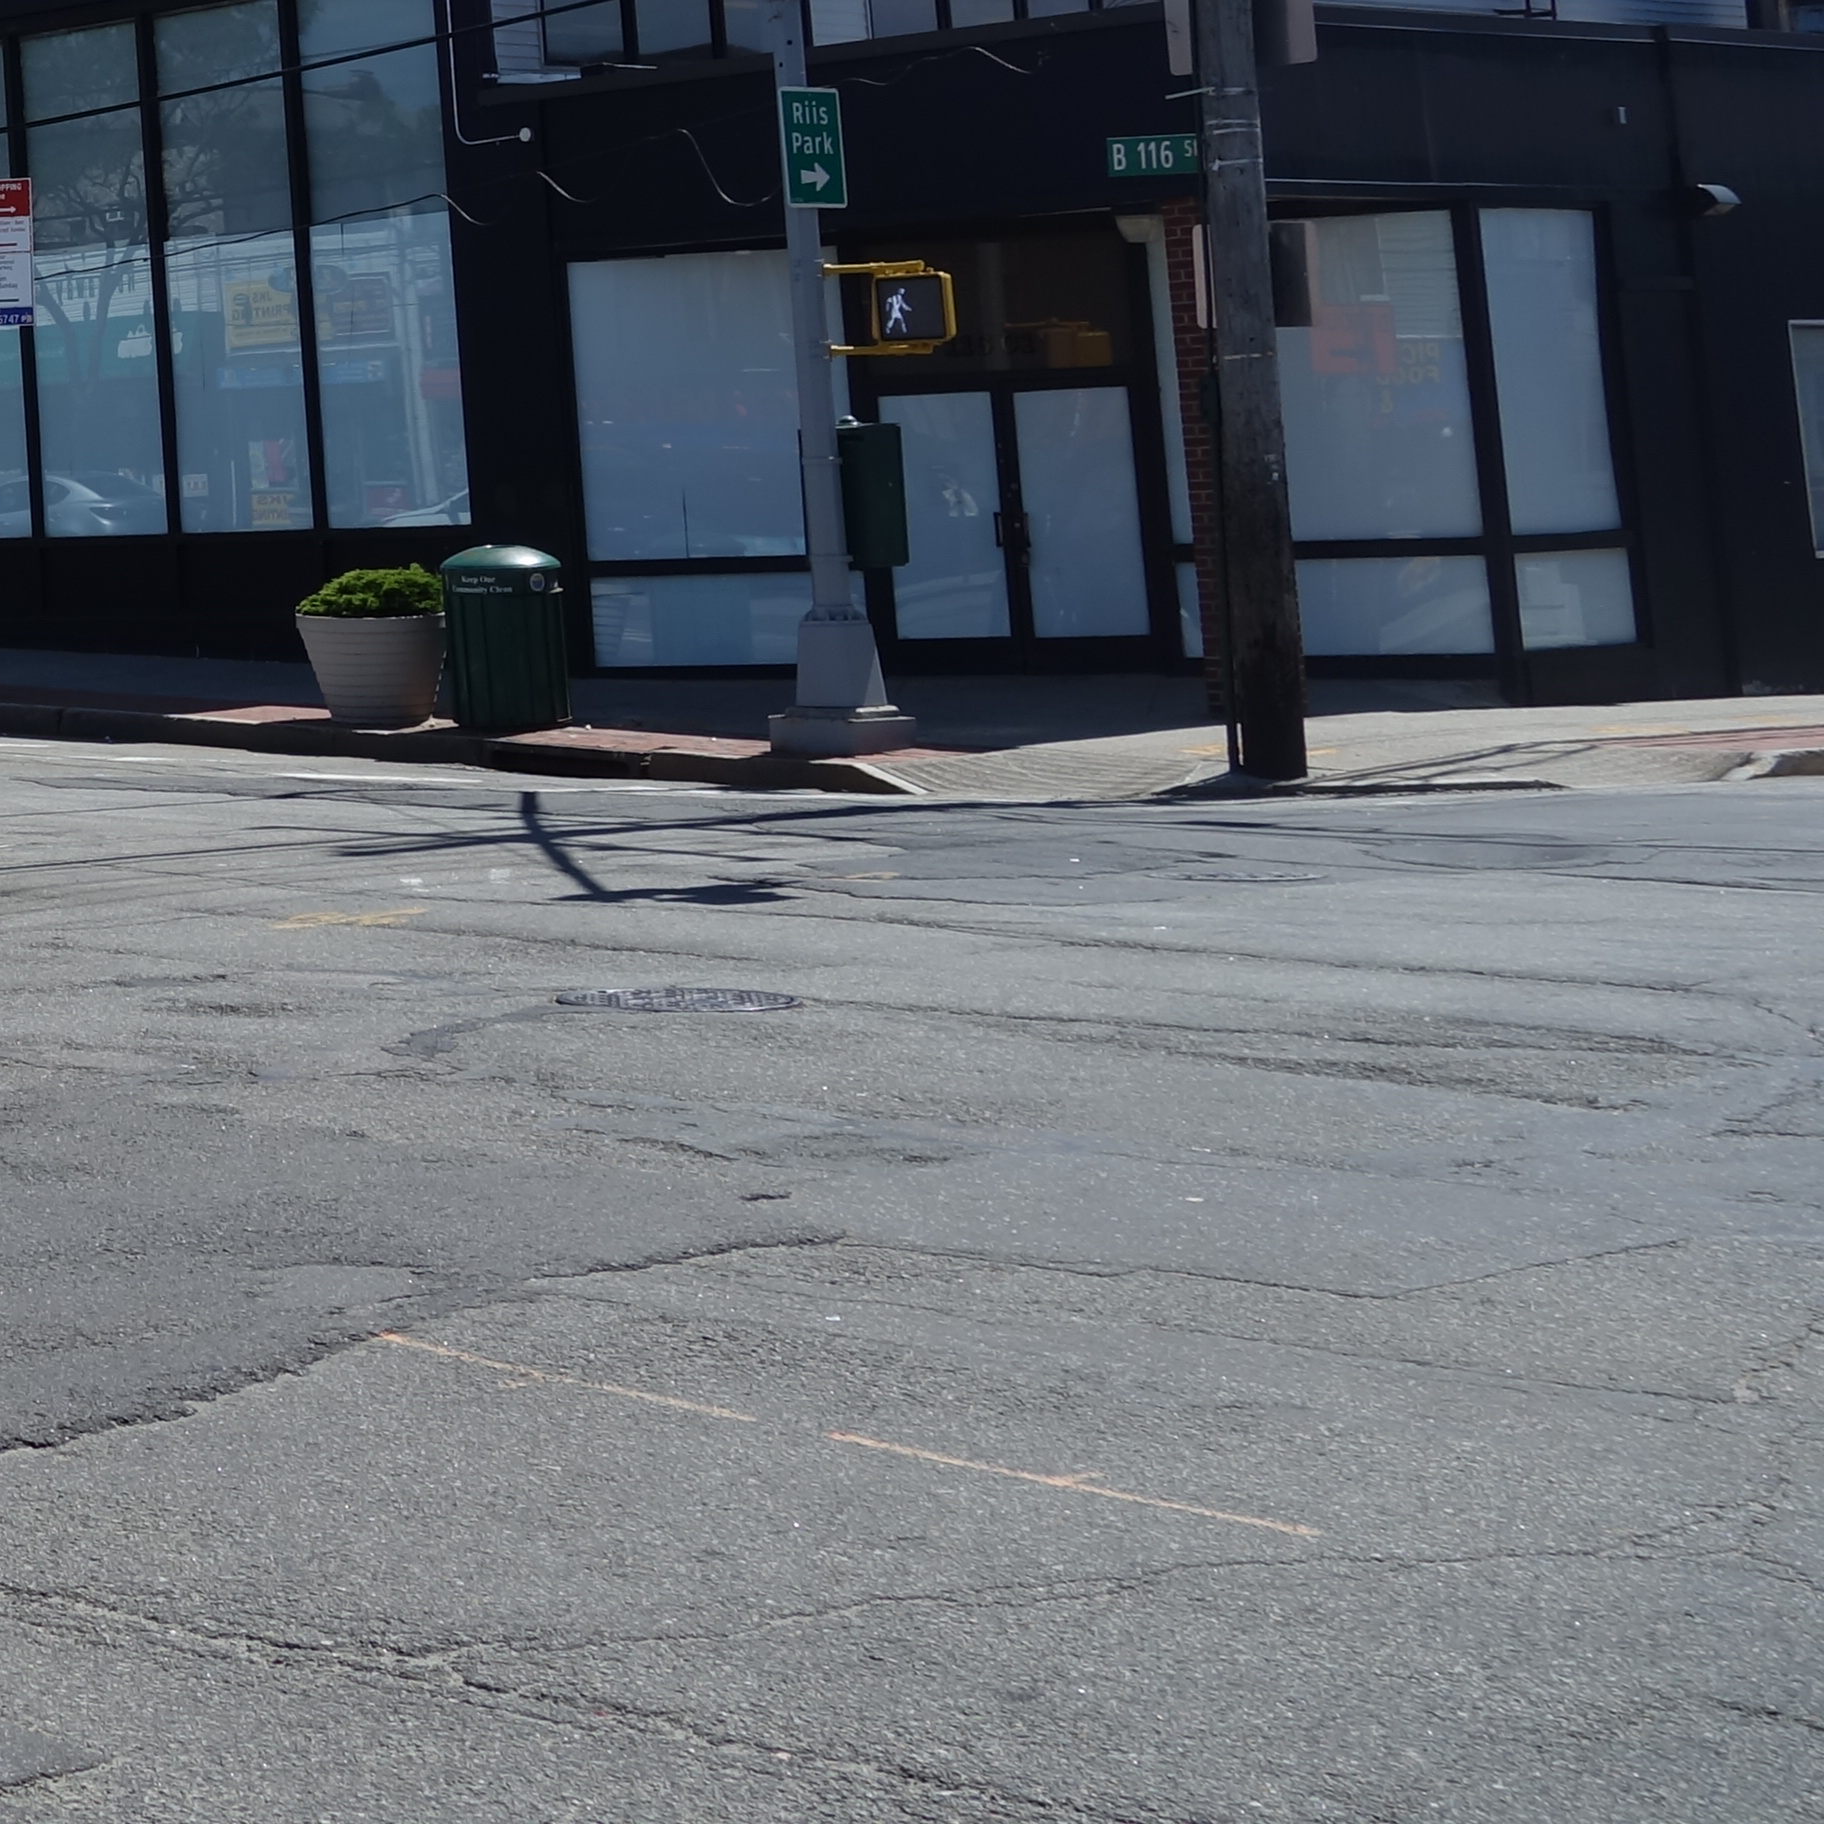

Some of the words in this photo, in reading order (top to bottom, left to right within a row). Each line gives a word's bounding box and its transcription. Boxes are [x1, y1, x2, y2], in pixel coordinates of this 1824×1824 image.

[792, 101, 828, 125] Riis
[792, 132, 834, 154] Park
[1112, 144, 1126, 171] B
[1137, 141, 1173, 169] 116
[461, 576, 478, 584] Keep
[489, 584, 513, 593] Clean
